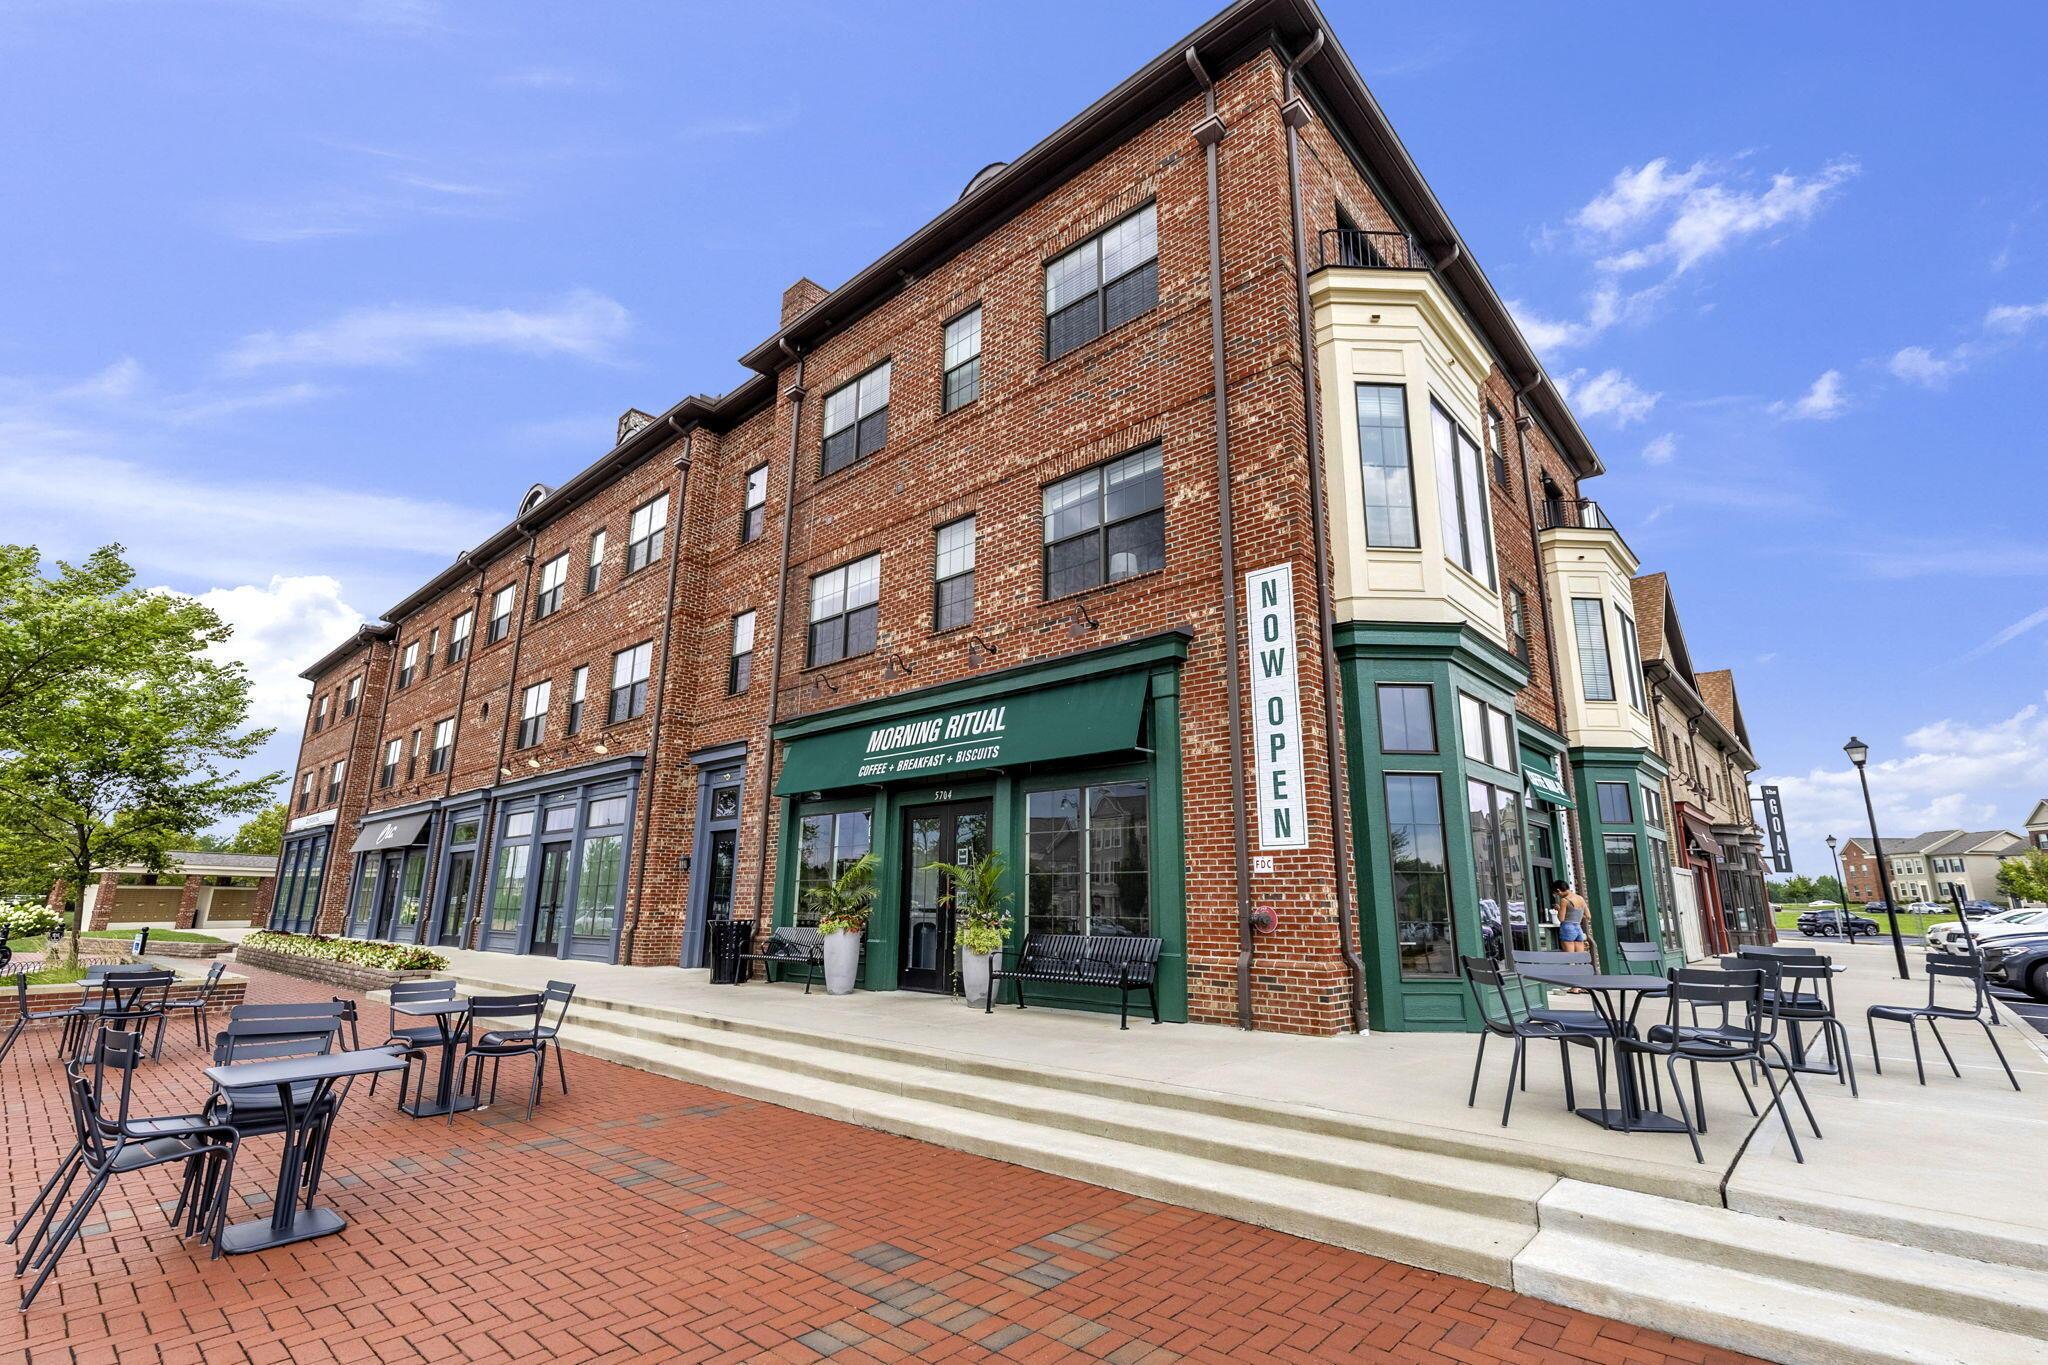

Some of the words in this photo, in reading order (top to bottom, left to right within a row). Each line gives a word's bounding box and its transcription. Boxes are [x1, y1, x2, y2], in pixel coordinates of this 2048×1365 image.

[1260, 579, 1285, 678] NOW
[866, 718, 943, 753] MORNING
[944, 706, 1006, 740] RITUAL
[858, 762, 888, 777] COFFEE
[897, 753, 945, 771] BREAKFAST
[947, 755, 953, 763] +
[955, 745, 1000, 763] BISCUITS
[1268, 696, 1292, 839] OPEN
[934, 790, 952, 800] 5704
[1769, 798, 1786, 870] GOAT
[1255, 859, 1272, 869] FDC
